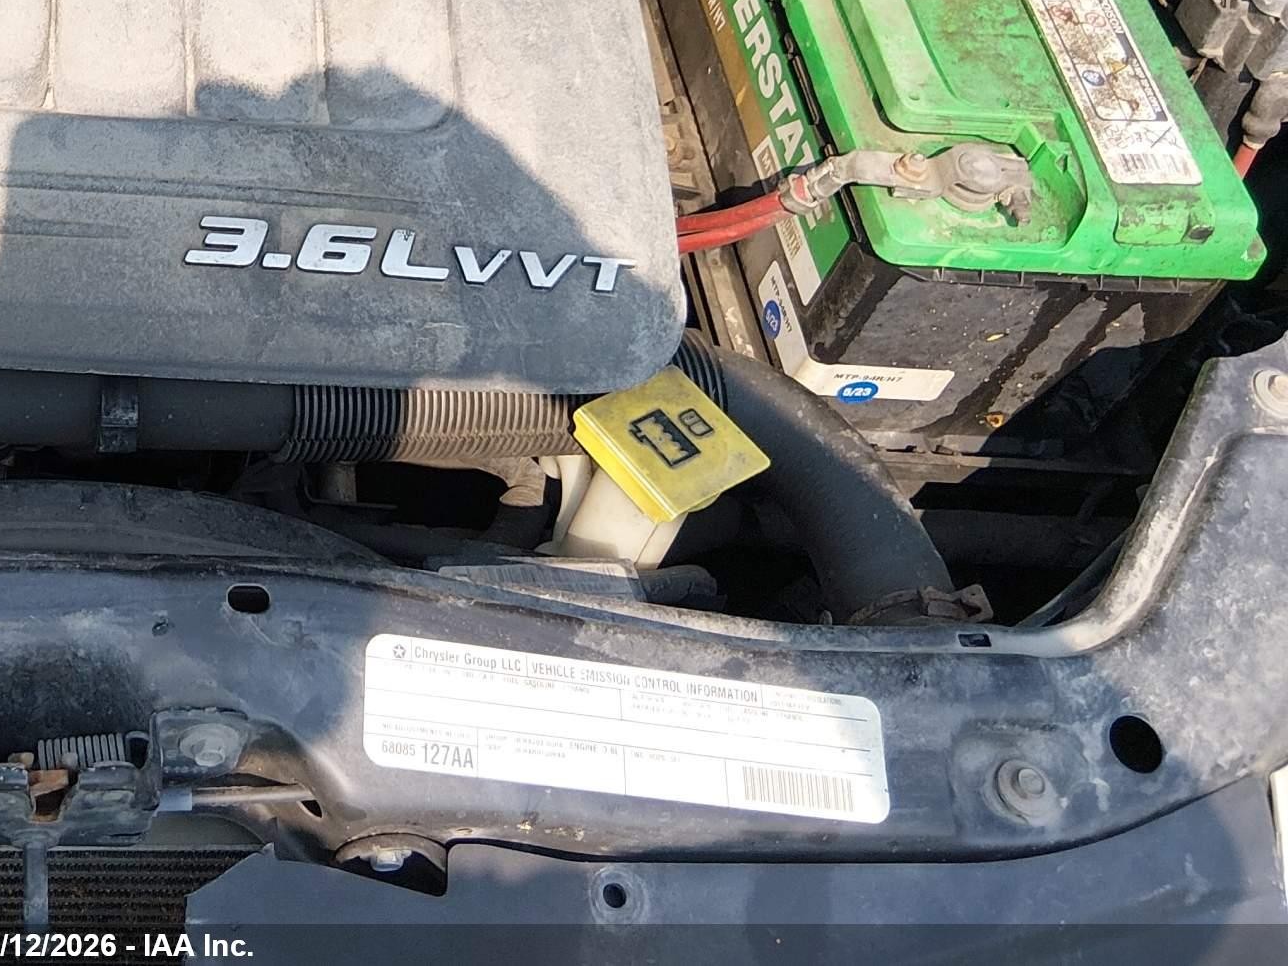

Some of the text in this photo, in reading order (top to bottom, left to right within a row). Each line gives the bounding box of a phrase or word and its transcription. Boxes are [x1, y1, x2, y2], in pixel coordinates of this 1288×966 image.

[414, 646, 522, 673] Chrysler Group LLC
[531, 661, 576, 680] VEHICLE
[634, 675, 682, 694] CONTROL
[686, 681, 758, 703] INFORMATION
[421, 742, 474, 770] 127AA
